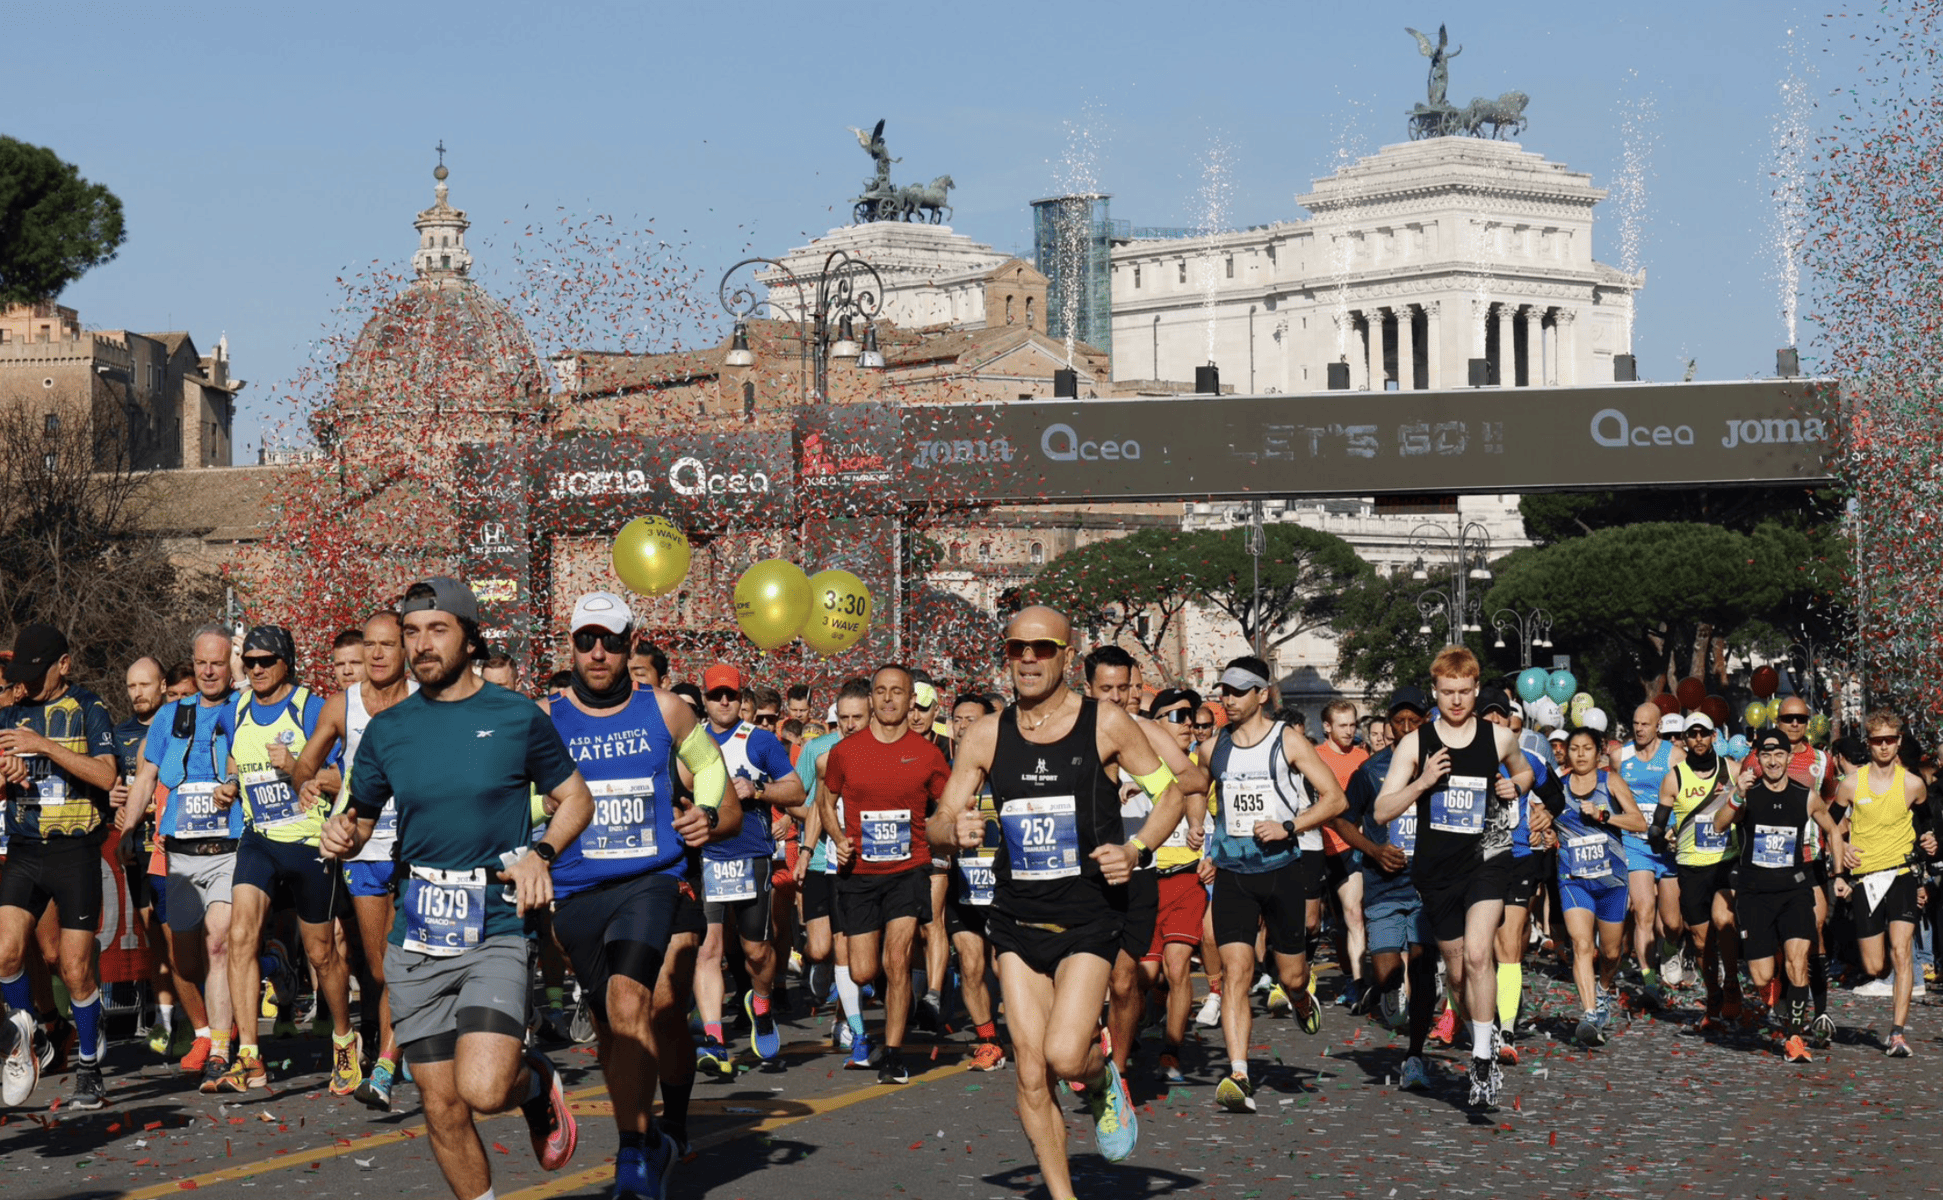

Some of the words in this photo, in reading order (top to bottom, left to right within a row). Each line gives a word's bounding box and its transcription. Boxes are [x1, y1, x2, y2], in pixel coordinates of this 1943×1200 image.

[1590, 408, 1694, 447] acea
[1041, 423, 1140, 461] acea
[669, 456, 768, 496] acea
[656, 529, 683, 546] WAVE
[823, 589, 866, 617] 3:30
[822, 616, 829, 625] 3
[832, 618, 860, 632] WAVE
[607, 728, 649, 743] ATLETICA
[569, 737, 652, 762] LATERZA
[253, 782, 291, 805] 10873
[1443, 789, 1474, 810] 1660
[1685, 786, 1706, 799] LAS
[1233, 794, 1264, 812] 4535
[593, 797, 645, 826] 13030
[187, 822, 193, 830] 8
[1235, 819, 1241, 828] 6
[1442, 815, 1448, 824] 3
[1461, 817, 1469, 826] C
[874, 822, 897, 840] 559
[1020, 816, 1057, 846] 252
[597, 836, 608, 848] 17
[626, 835, 637, 847] C
[1765, 835, 1786, 850] 582
[890, 846, 898, 855] C
[1575, 844, 1605, 862] F4739
[1046, 856, 1059, 868] C
[713, 860, 745, 880] 9462
[716, 886, 723, 895] 12
[735, 884, 743, 893] C
[417, 884, 469, 920] 11379
[424, 916, 449, 926] IGNACIO
[418, 927, 427, 942] 15
[445, 932, 458, 946] C
